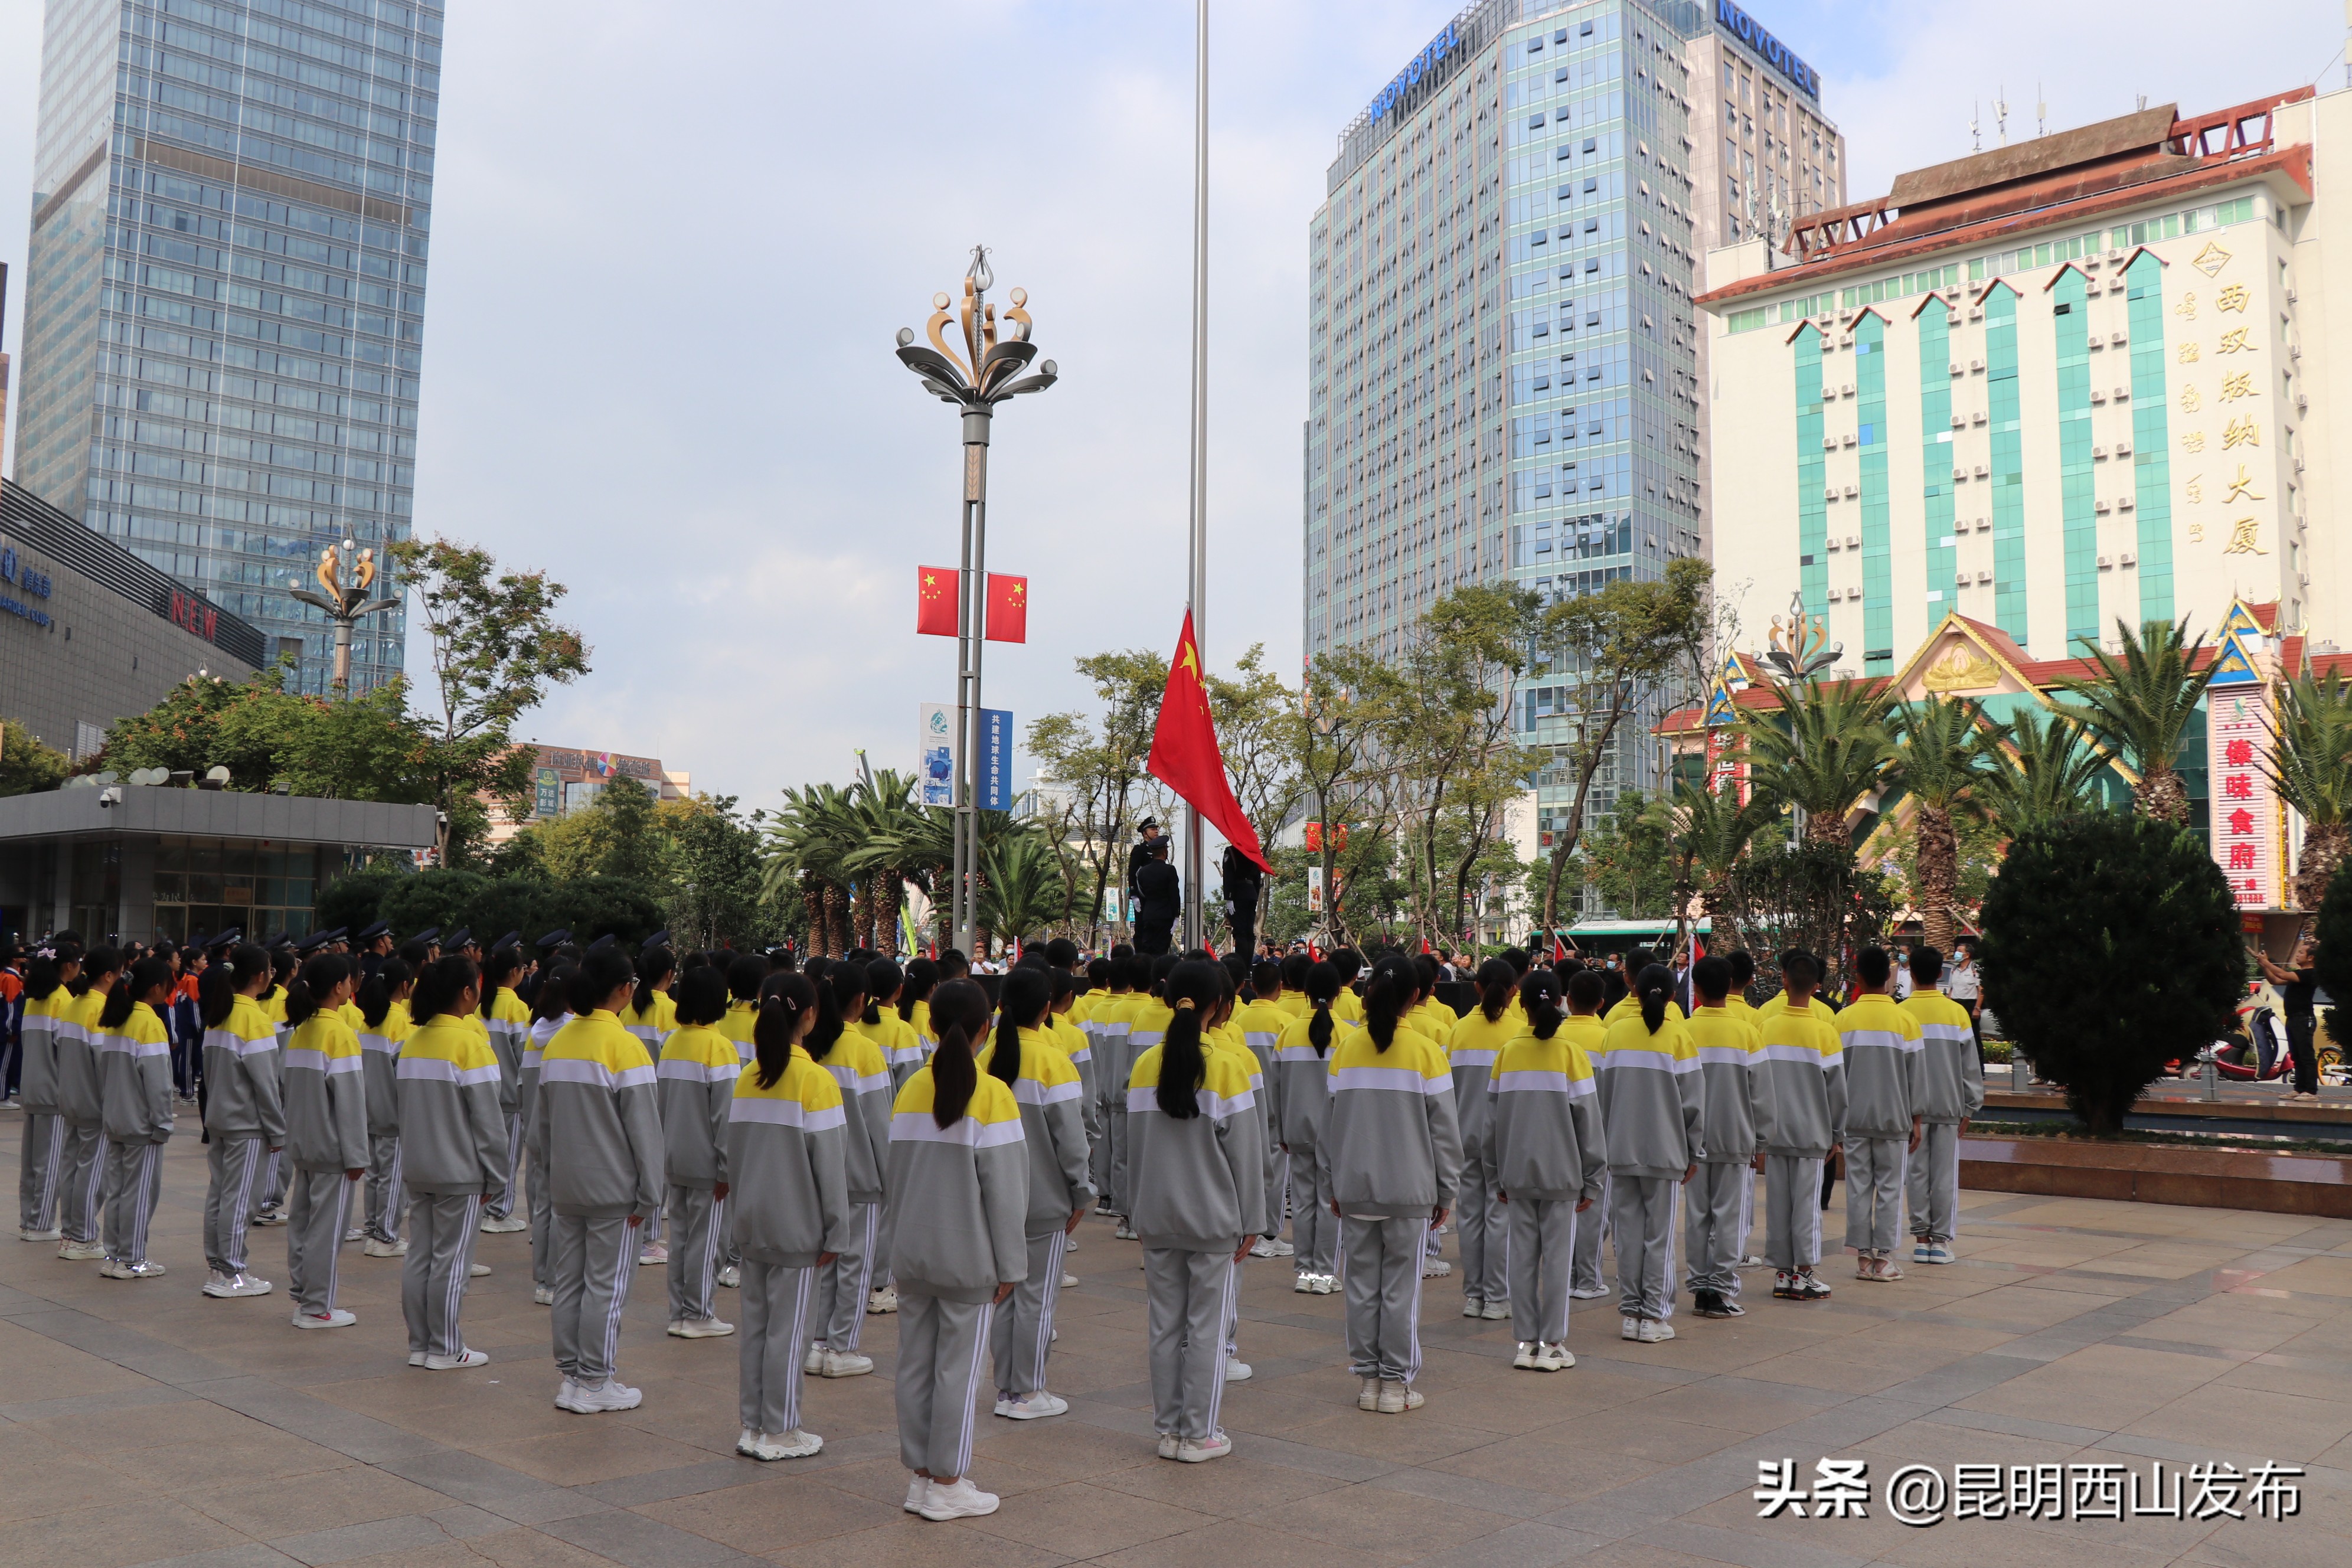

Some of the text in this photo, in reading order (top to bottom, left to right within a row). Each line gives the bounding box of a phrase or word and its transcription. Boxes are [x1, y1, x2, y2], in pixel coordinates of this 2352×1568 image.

[1370, 22, 1459, 126] NOVOTEL
[1719, 0, 1817, 96] NOVOTEL
[2215, 281, 2270, 556] 西双版纳大厦
[30, 608, 50, 627] CLUB
[540, 788, 555, 798] 万达
[551, 751, 597, 771] 南亚风情
[989, 714, 1000, 806] 共建地球生命共同体
[2225, 739, 2256, 870] 傣味食府
